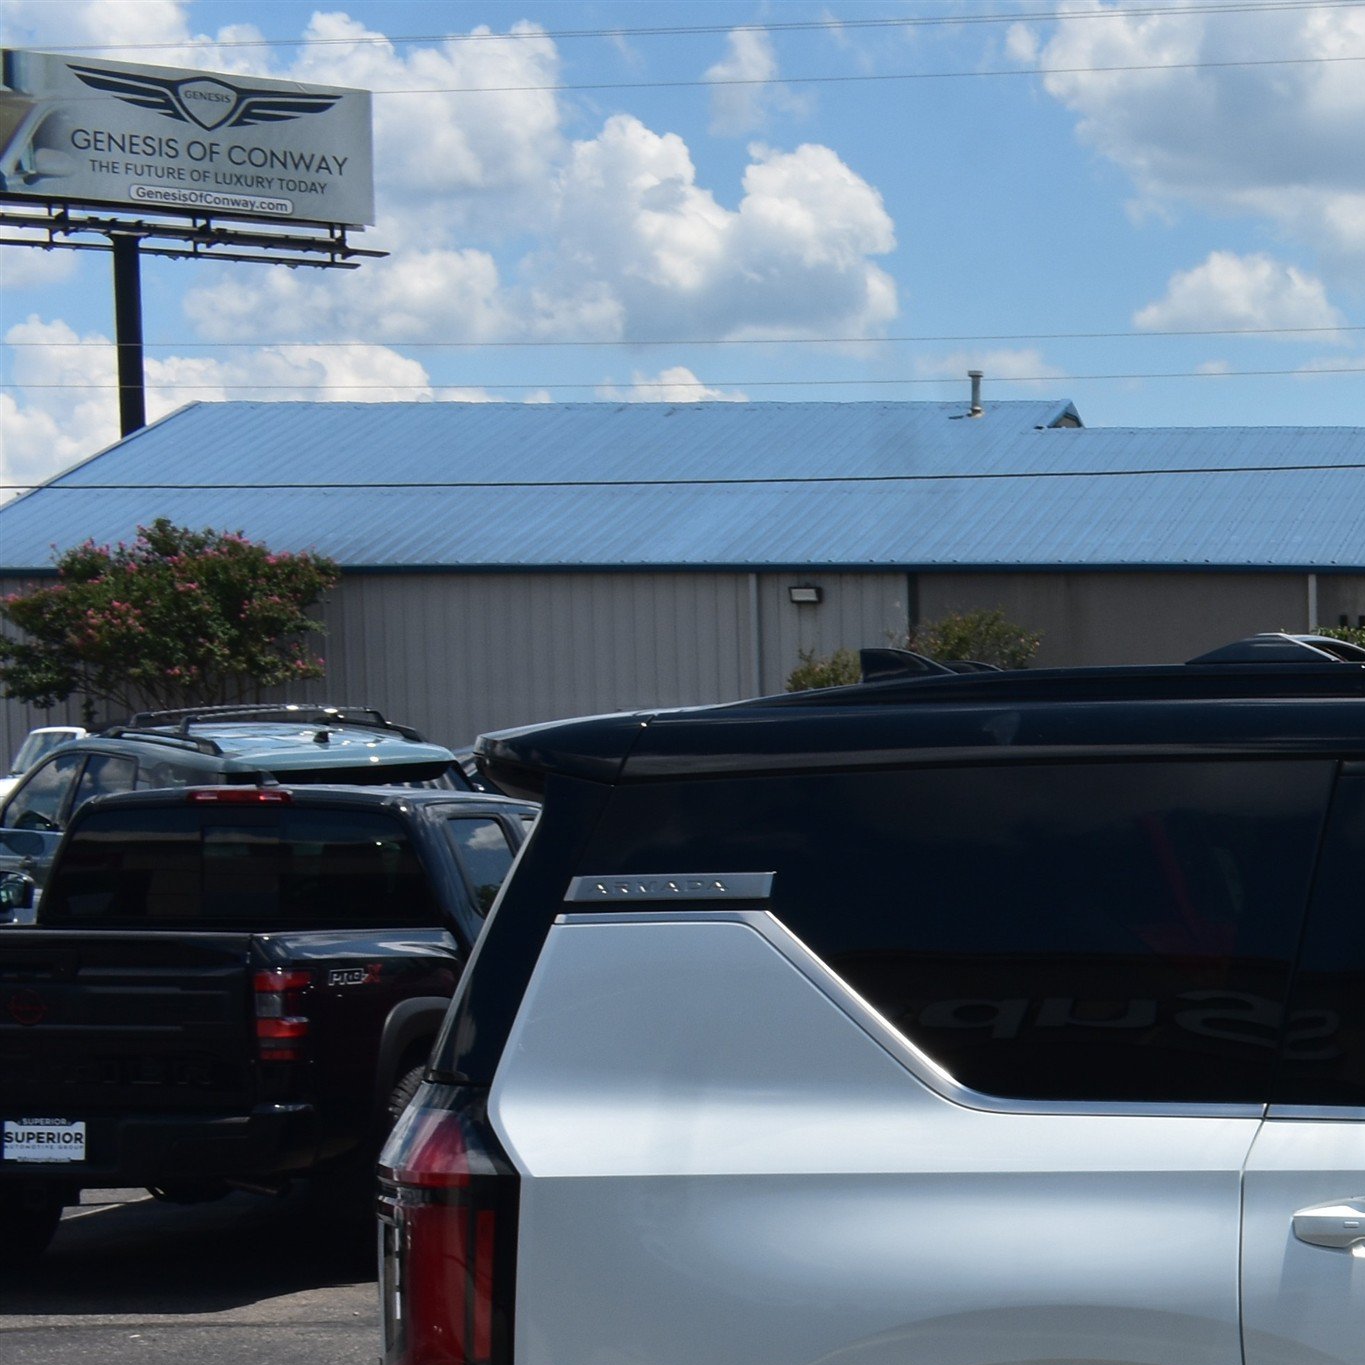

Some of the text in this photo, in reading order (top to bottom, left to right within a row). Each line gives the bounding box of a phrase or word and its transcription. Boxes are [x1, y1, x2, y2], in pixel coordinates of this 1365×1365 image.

[184, 90, 232, 103] GENESIS
[70, 128, 348, 176] GENESIS OF CONWAY
[89, 159, 328, 195] THE FUTURE OF LUXURY TODAY
[135, 187, 288, 212] GenesisOfConway.com
[588, 879, 730, 895] ARMADA
[22, 1117, 67, 1126] SUPERIOR
[4, 1131, 84, 1144] SUPERIOR
